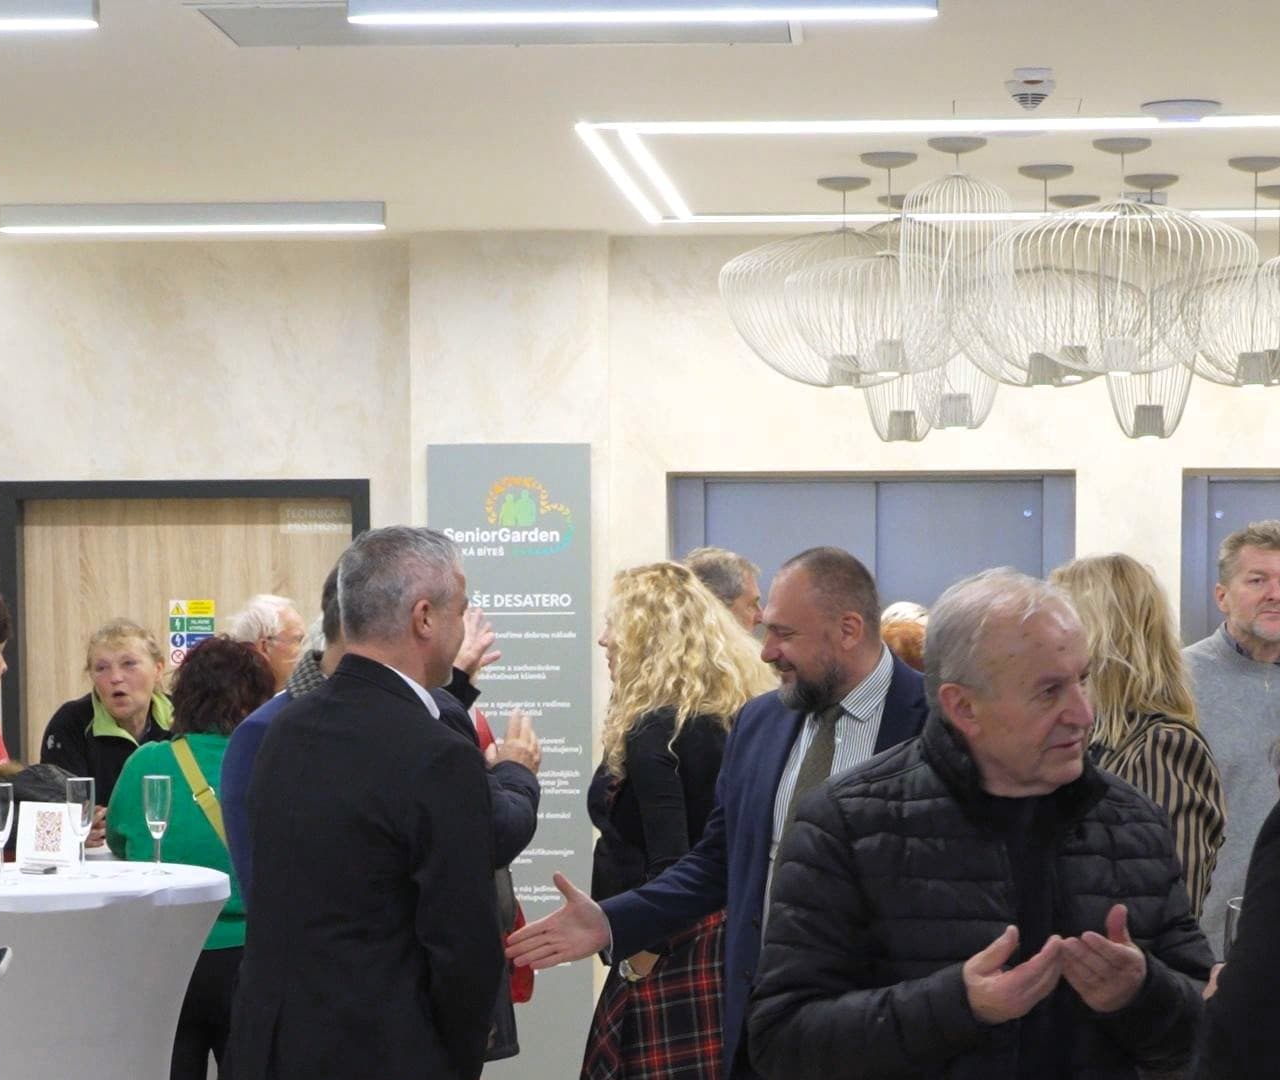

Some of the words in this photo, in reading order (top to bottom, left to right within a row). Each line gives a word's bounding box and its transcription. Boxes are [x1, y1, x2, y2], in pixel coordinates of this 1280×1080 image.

[443, 528, 560, 542] SeniorGarden
[477, 546, 504, 556] BÍTEŠ
[494, 593, 572, 607] DESATERO
